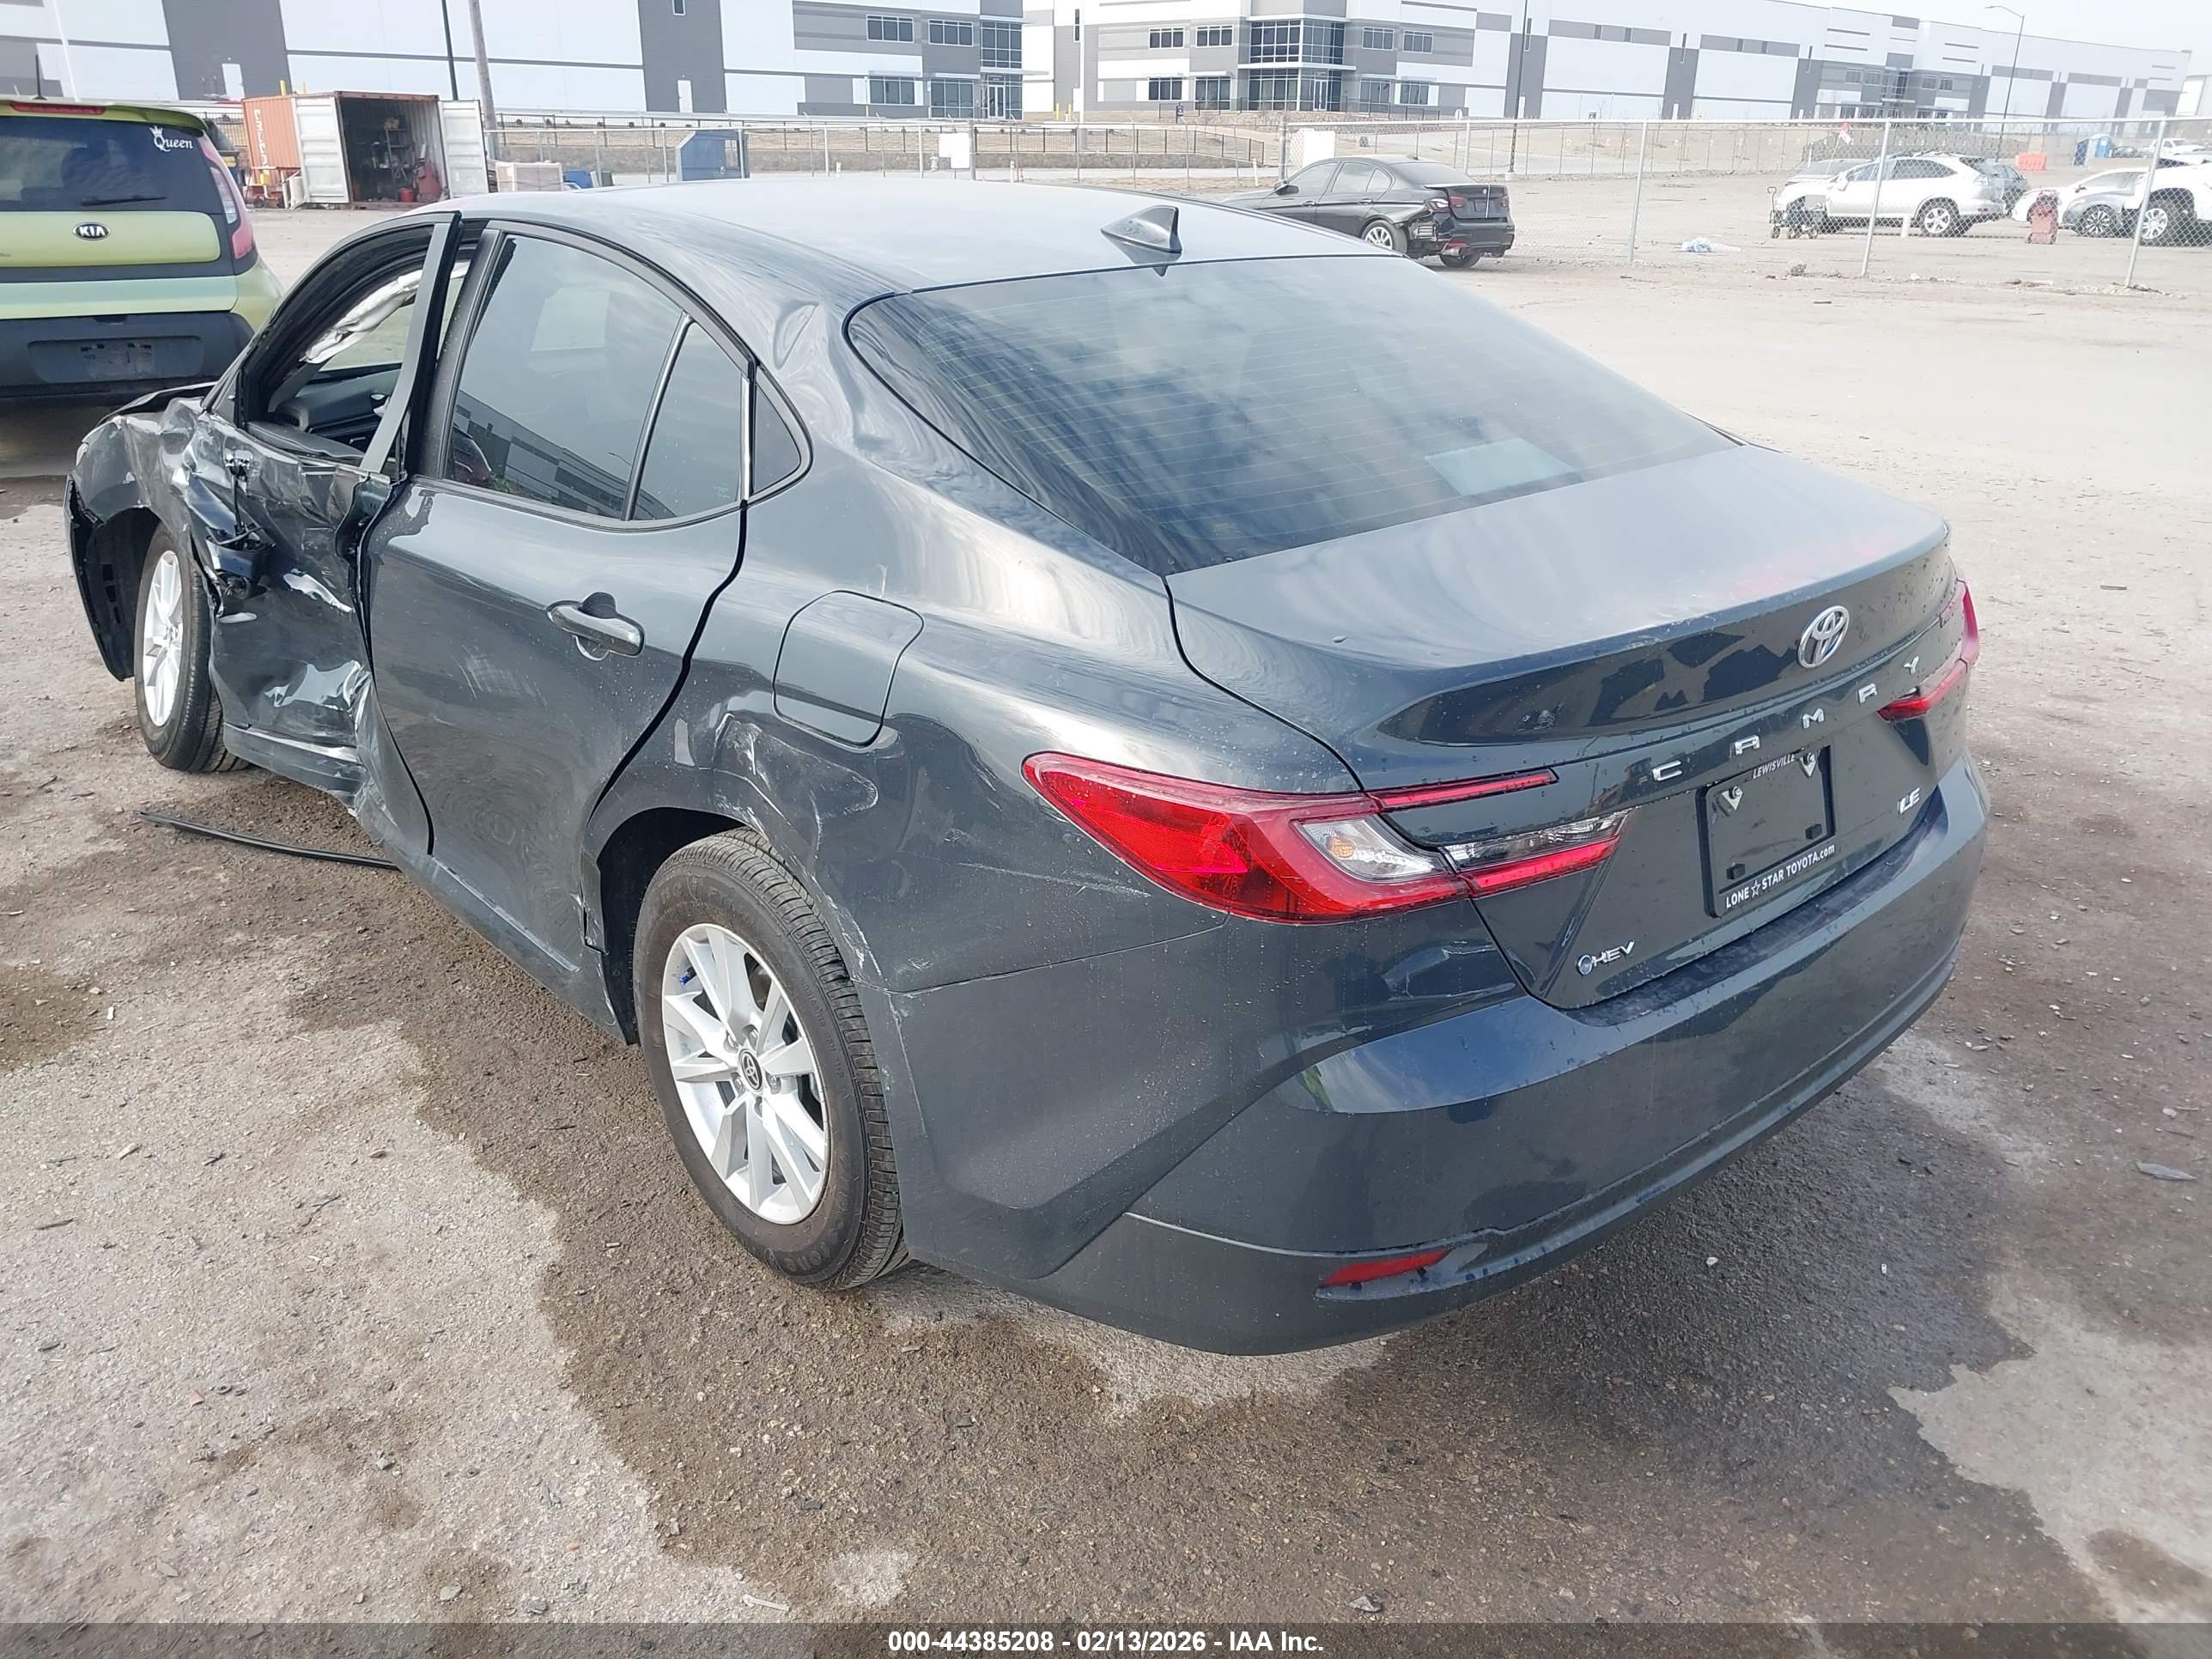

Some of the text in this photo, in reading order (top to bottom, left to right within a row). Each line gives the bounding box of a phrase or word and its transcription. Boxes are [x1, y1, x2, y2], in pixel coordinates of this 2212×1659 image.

[154, 136, 193, 152] Queen
[79, 226, 106, 237] KIA
[1652, 655, 1920, 782] CAMRY
[1753, 754, 1796, 780] LEWISVILLE
[1899, 787, 1920, 815] LE
[1726, 845, 1835, 908] LONE STAR TOYOTA.com
